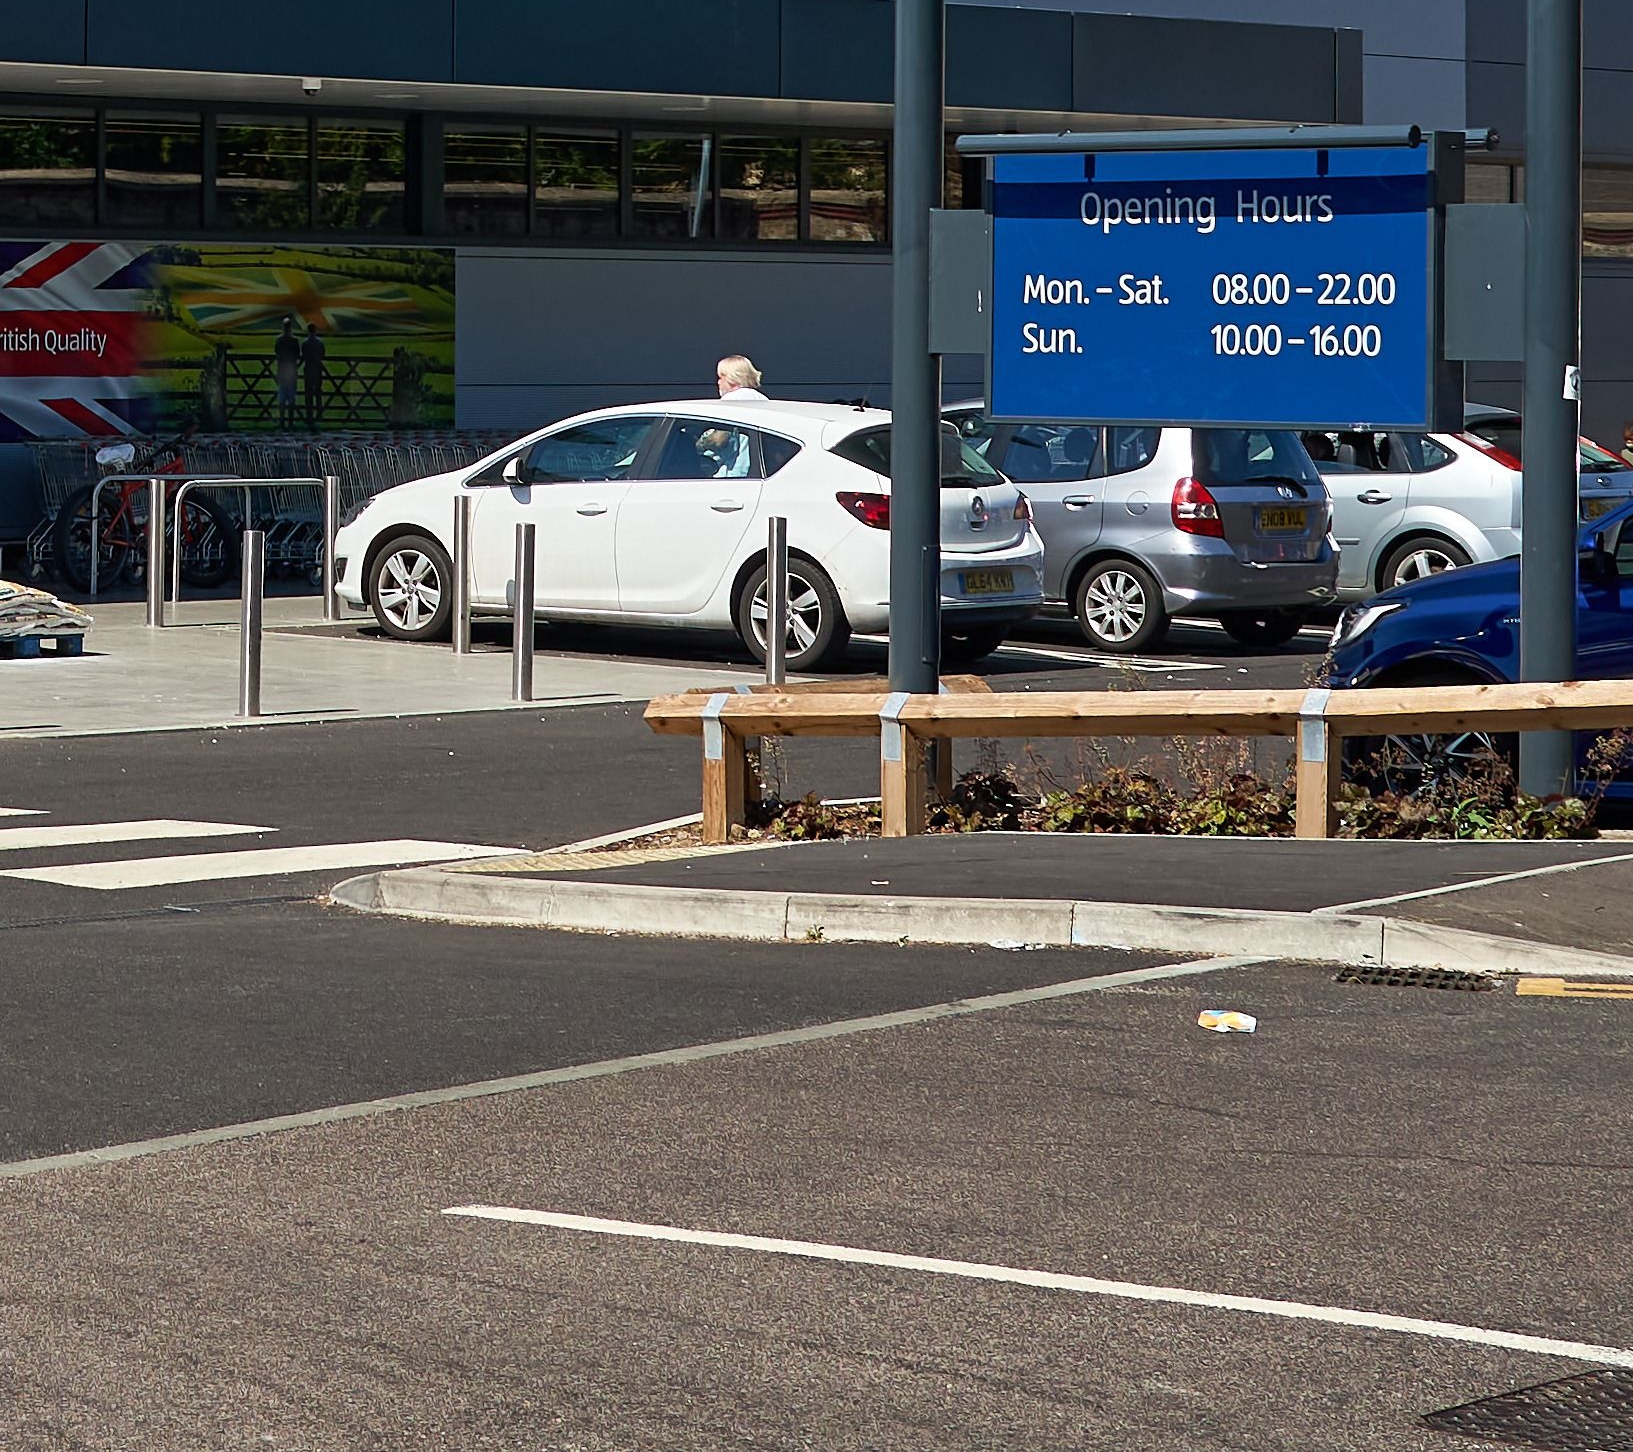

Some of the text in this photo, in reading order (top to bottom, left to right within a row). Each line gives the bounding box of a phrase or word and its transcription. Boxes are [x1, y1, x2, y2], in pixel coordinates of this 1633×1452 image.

[1080, 188, 1334, 234] Opening Hours
[1023, 274, 1090, 305] Mon.
[1118, 273, 1170, 305] Sat.
[1212, 273, 1290, 305] 08.00
[1316, 273, 1396, 305] 22.00
[44, 328, 107, 358] Quality
[1022, 323, 1083, 354] Sun.
[1210, 324, 1282, 356] 10.00
[1309, 324, 1381, 357] 16.00
